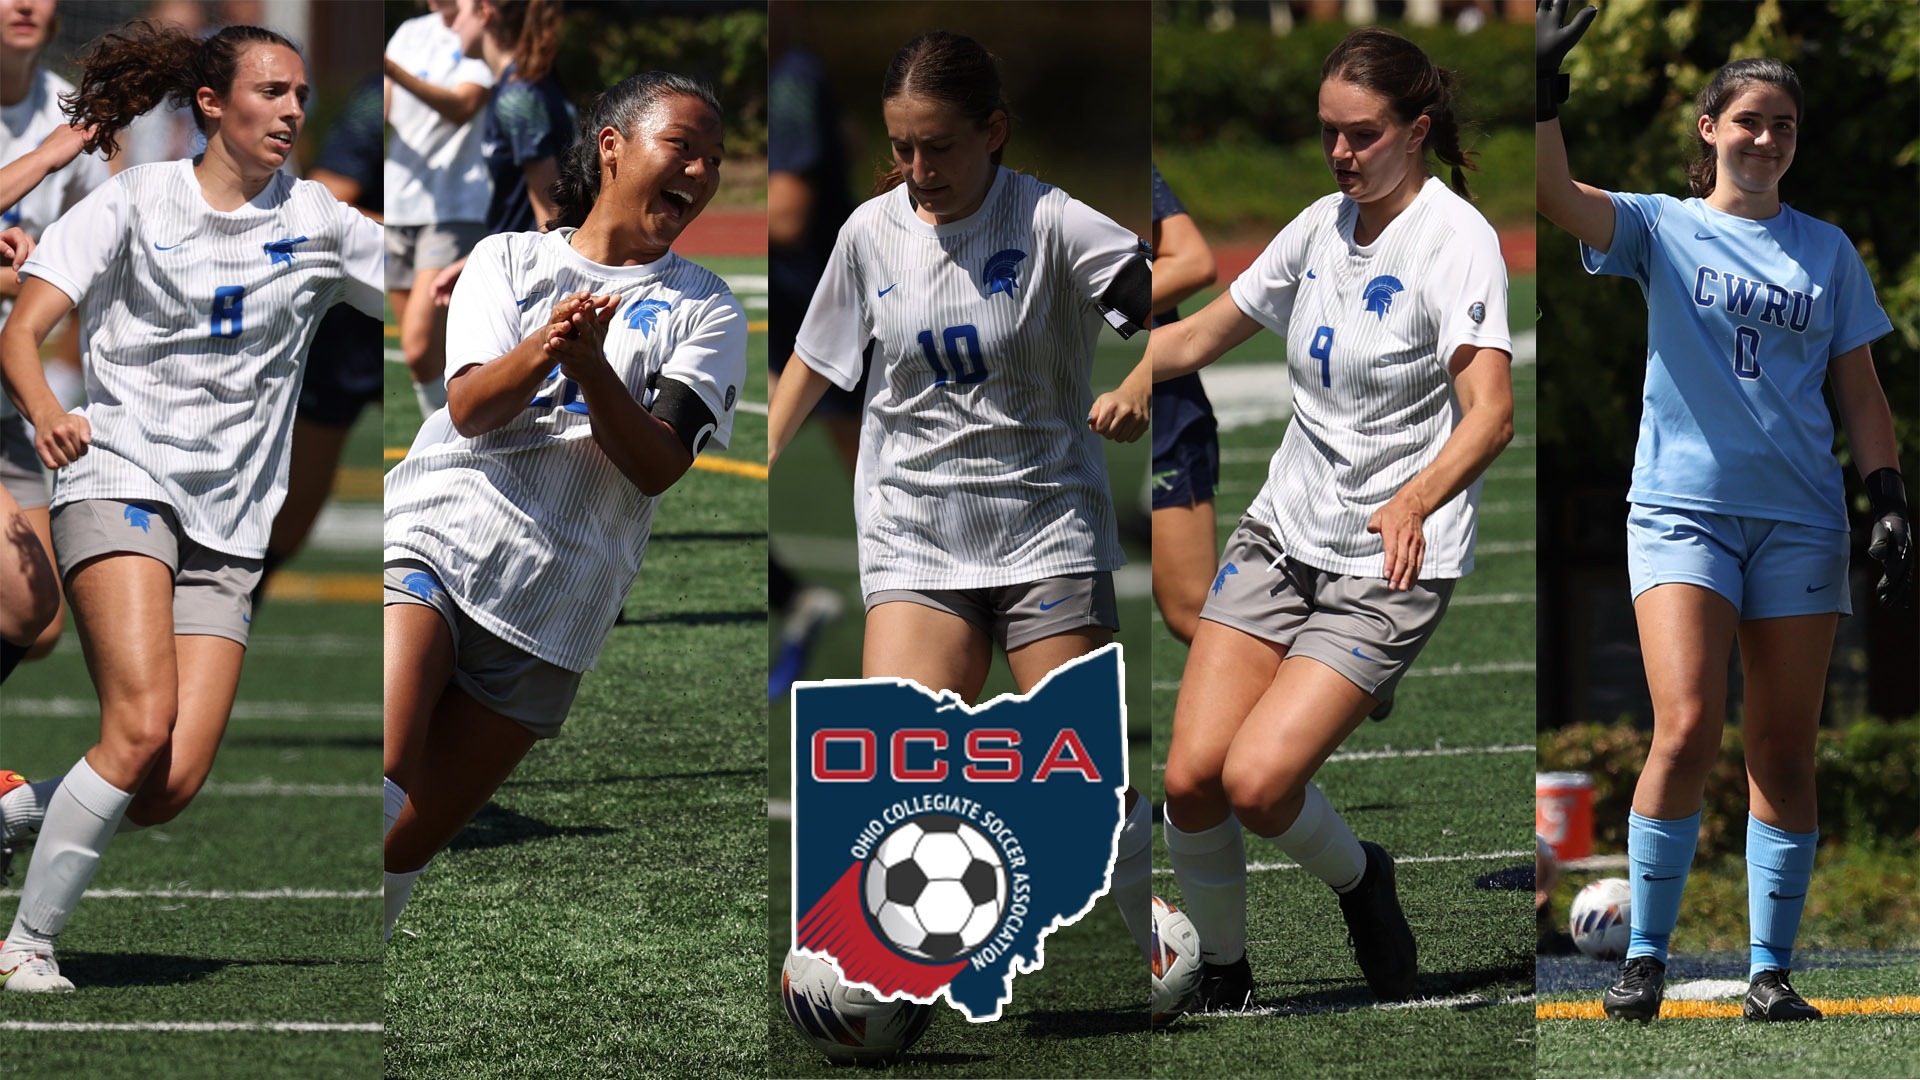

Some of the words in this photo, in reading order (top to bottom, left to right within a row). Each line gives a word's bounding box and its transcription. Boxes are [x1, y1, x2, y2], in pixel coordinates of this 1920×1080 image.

[210, 286, 245, 339] 8
[1693, 265, 1815, 334] CWRU
[917, 324, 988, 388] 10
[1309, 325, 1335, 388] 9
[1733, 324, 1762, 381] 0
